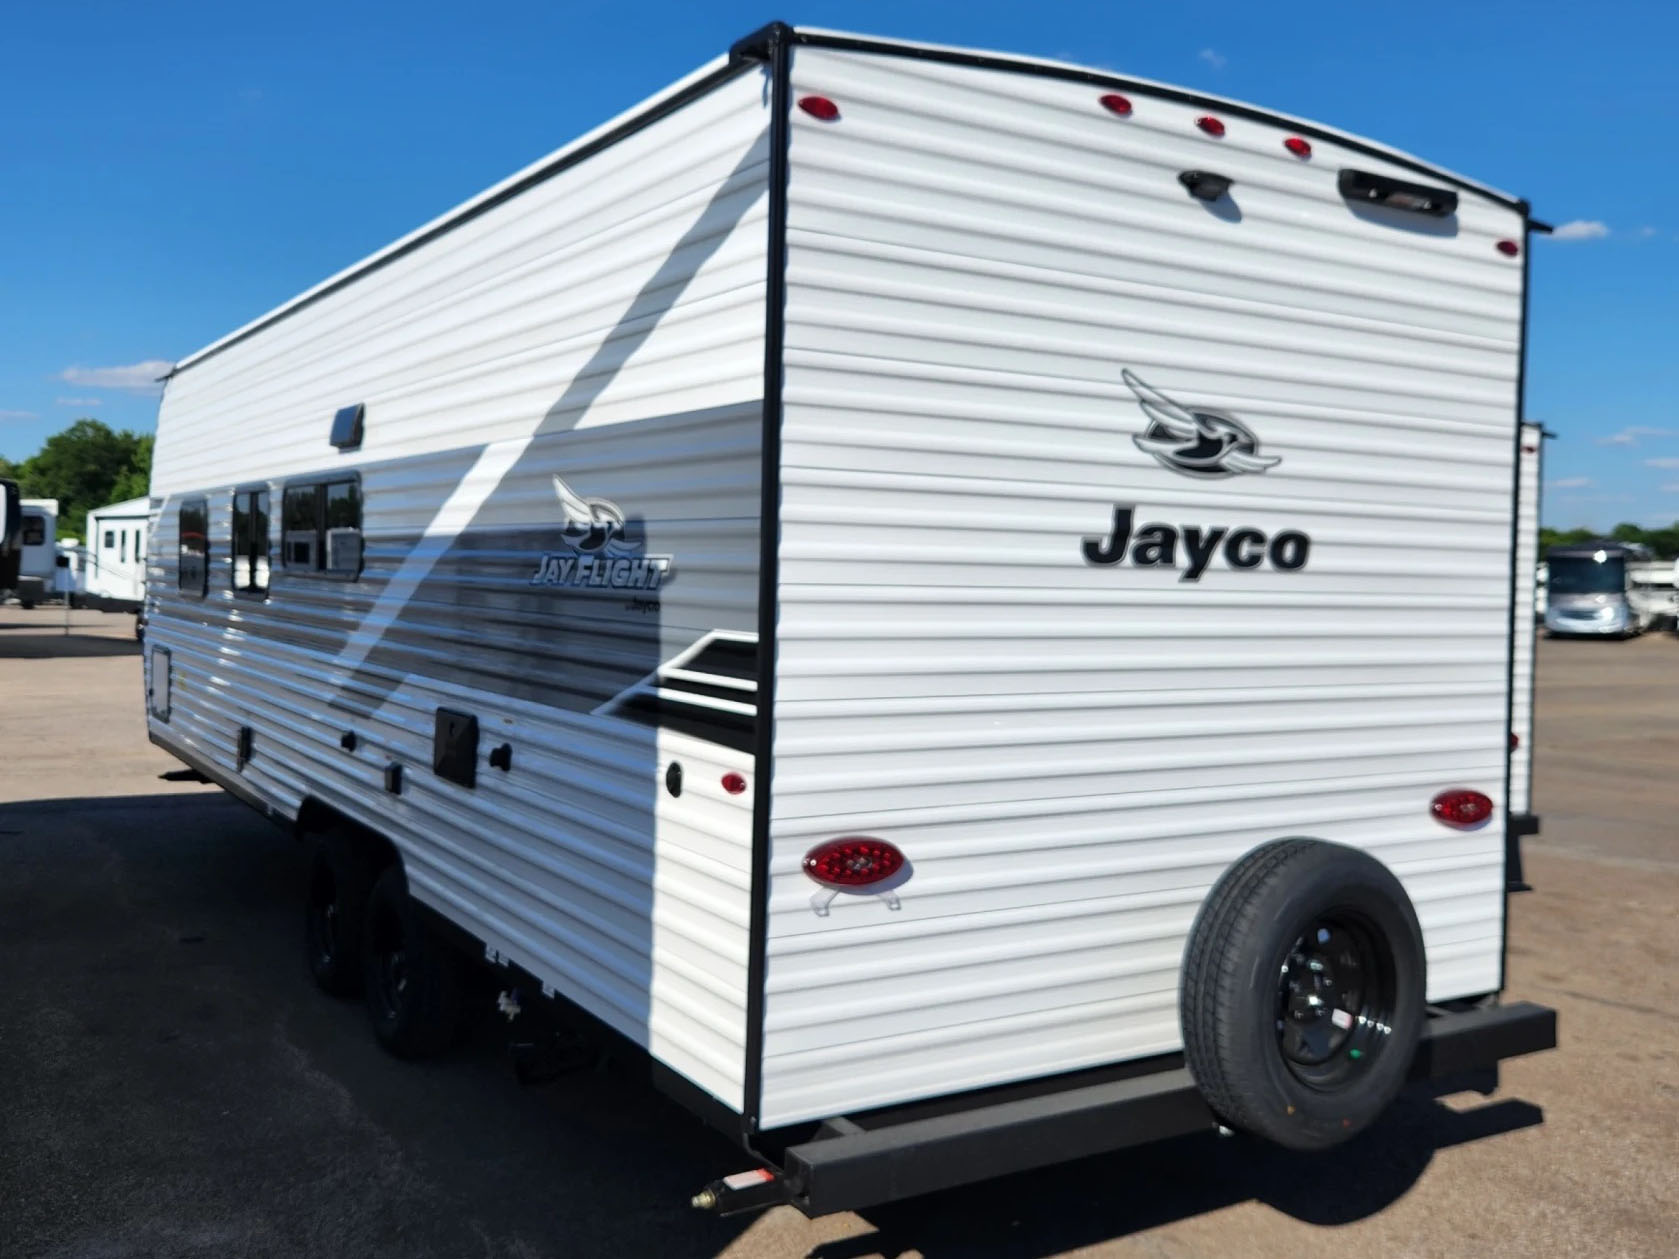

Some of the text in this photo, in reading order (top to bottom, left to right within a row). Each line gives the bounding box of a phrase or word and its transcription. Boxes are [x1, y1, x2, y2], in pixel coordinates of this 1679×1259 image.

[532, 553, 674, 590] JAY FLIGHT
[1081, 503, 1311, 583] Jayco
